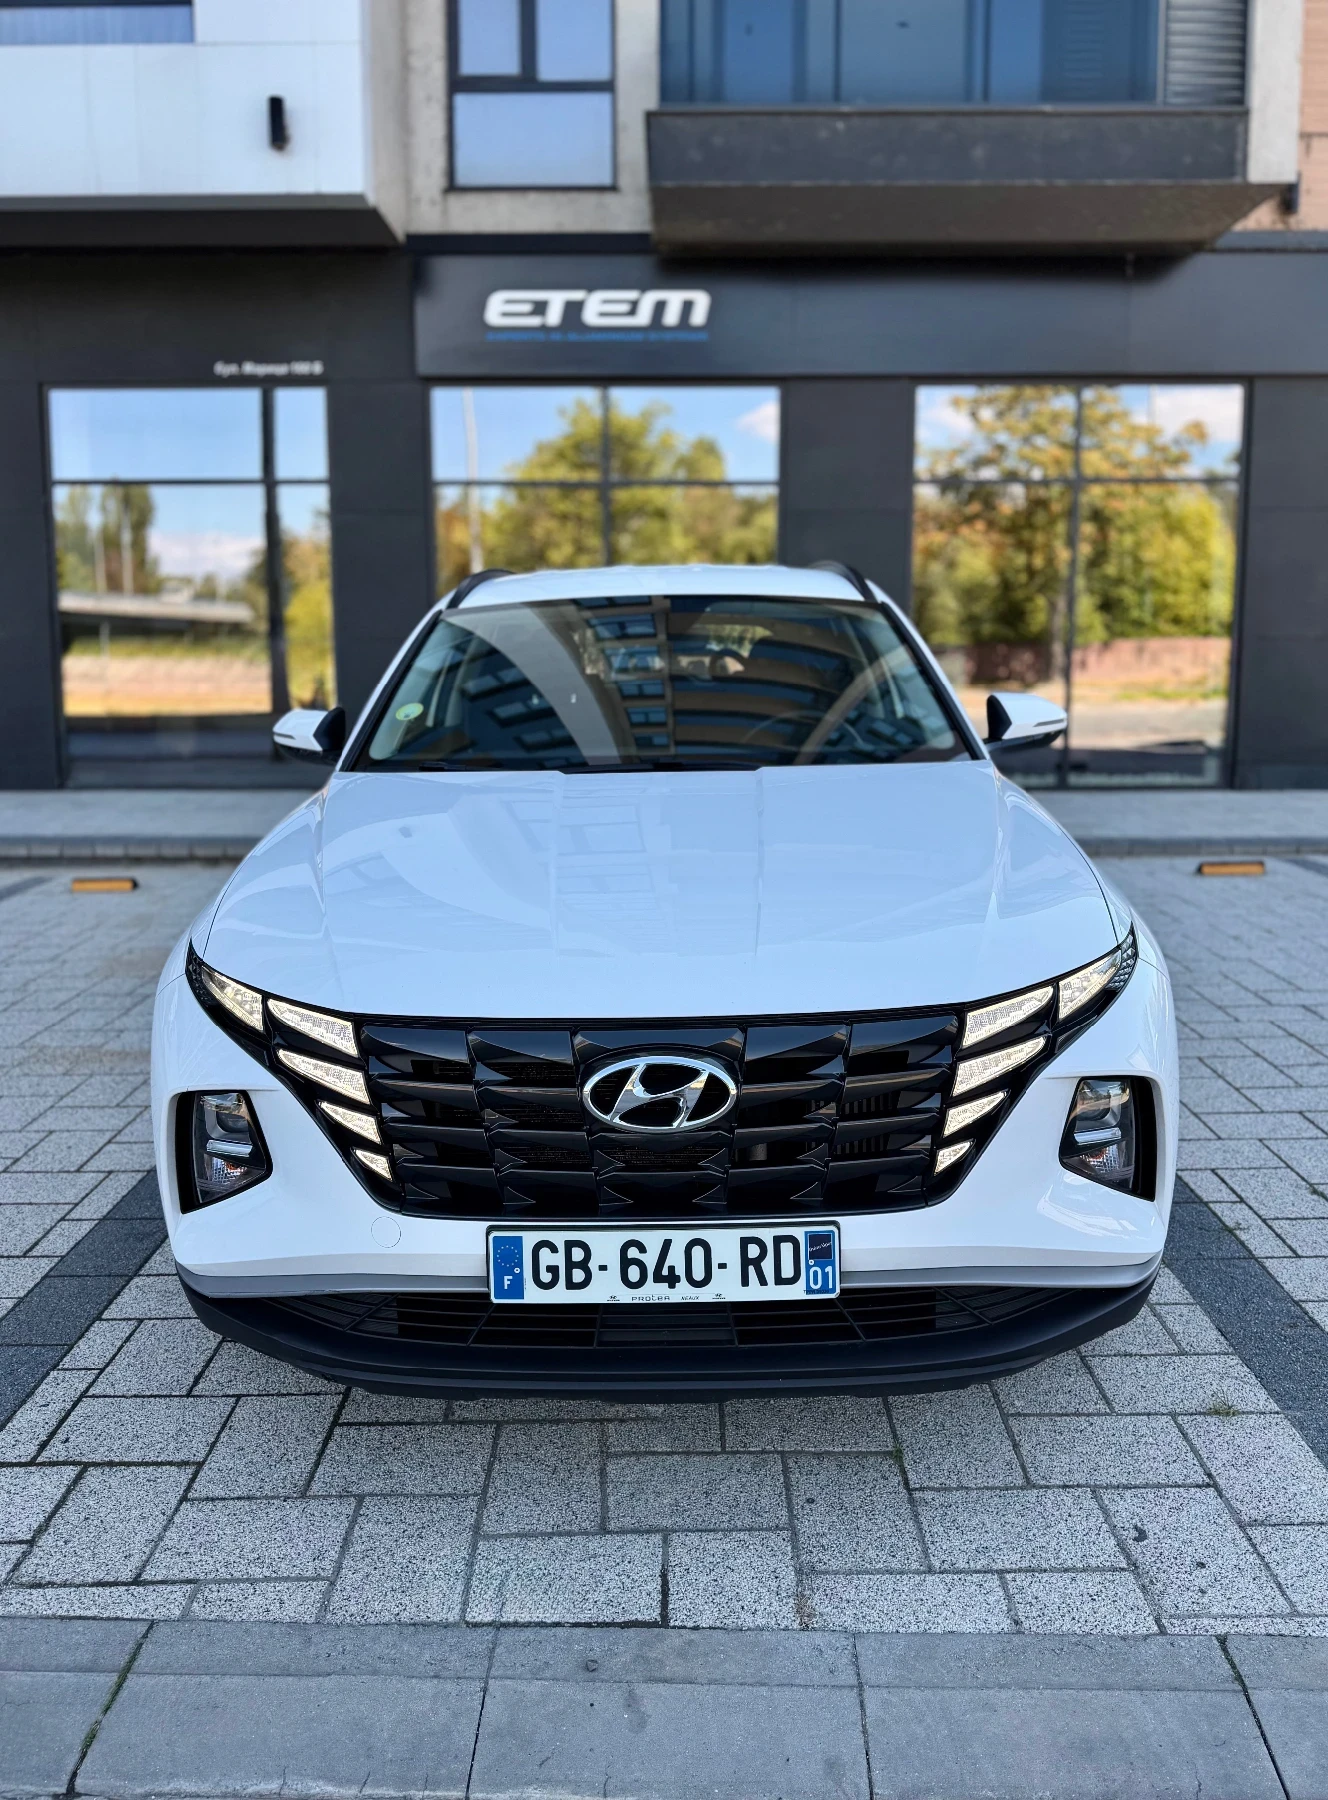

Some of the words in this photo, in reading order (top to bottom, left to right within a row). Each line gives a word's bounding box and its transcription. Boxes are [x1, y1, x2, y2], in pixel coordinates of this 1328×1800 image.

[483, 289, 712, 328] ETEM
[503, 1275, 513, 1290] F
[809, 1265, 833, 1290] 01
